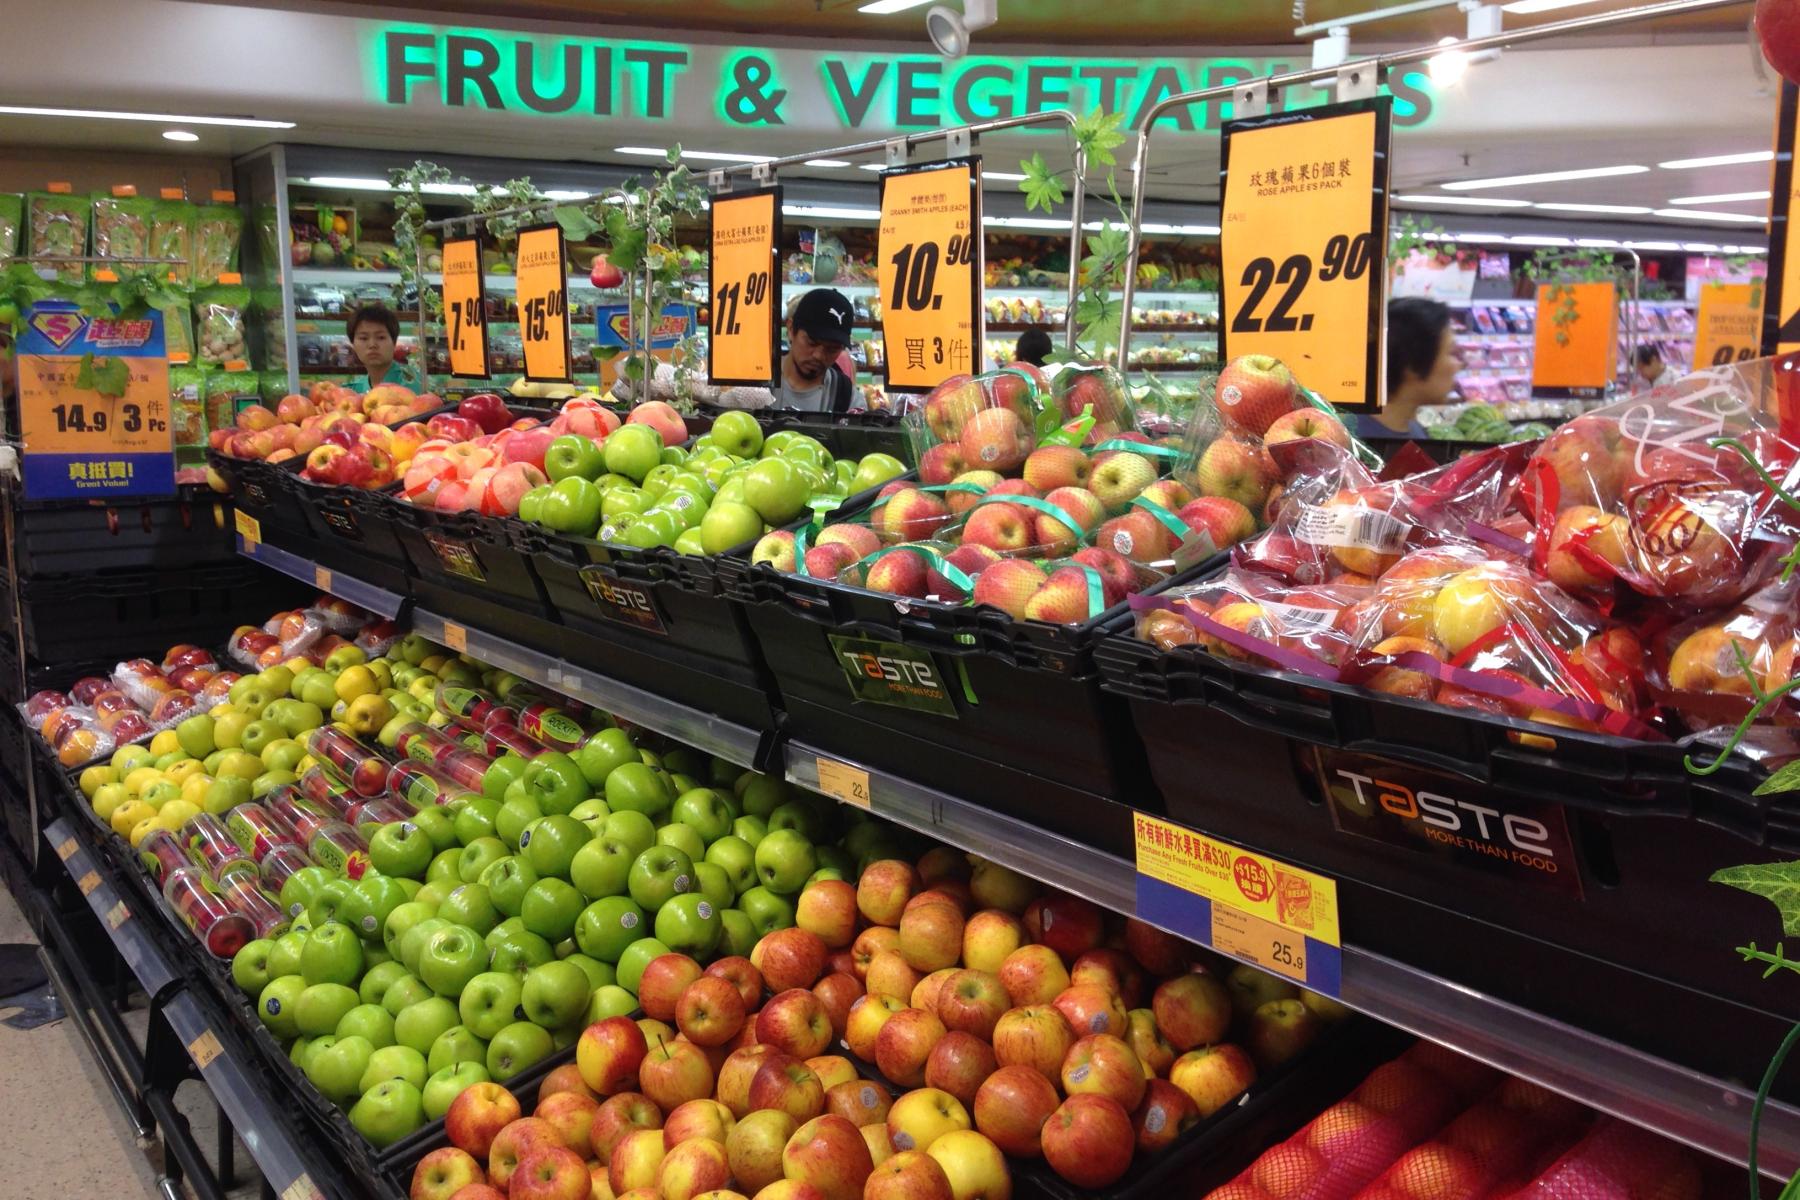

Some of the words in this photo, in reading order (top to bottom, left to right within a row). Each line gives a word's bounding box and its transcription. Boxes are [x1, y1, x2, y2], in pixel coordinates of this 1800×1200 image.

[385, 32, 687, 118] FRUIT
[725, 56, 787, 124] &
[1257, 188, 1277, 197] ROSE
[1280, 184, 1305, 193] APPLE
[1320, 180, 1343, 189] PACK
[933, 336, 944, 364] 3
[948, 338, 969, 371] 件
[123, 404, 142, 432] 3
[1173, 855, 1187, 866] Fresh
[1425, 827, 1465, 848] MORE
[1466, 838, 1508, 860] THAN
[1512, 851, 1558, 873] FOOD
[1272, 941, 1303, 970] 25.9
